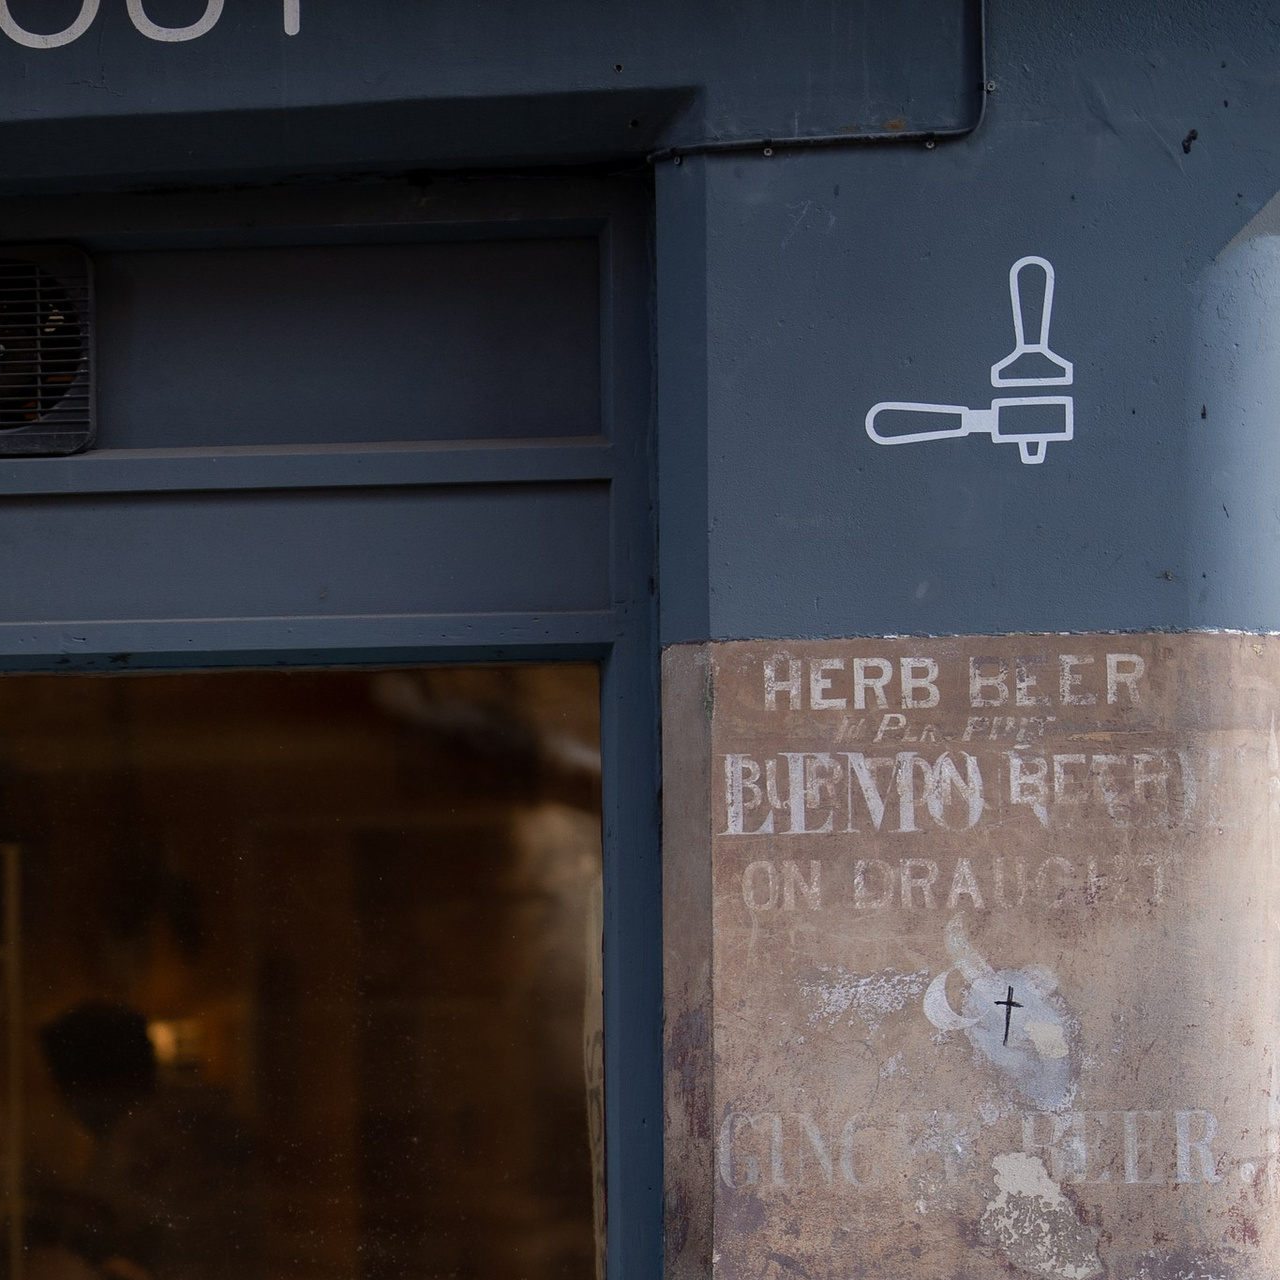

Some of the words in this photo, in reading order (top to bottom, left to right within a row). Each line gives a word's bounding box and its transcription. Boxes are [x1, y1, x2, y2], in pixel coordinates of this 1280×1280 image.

[763, 656, 941, 712] HERB
[968, 653, 1146, 708] BEER
[742, 858, 822, 912] ON
